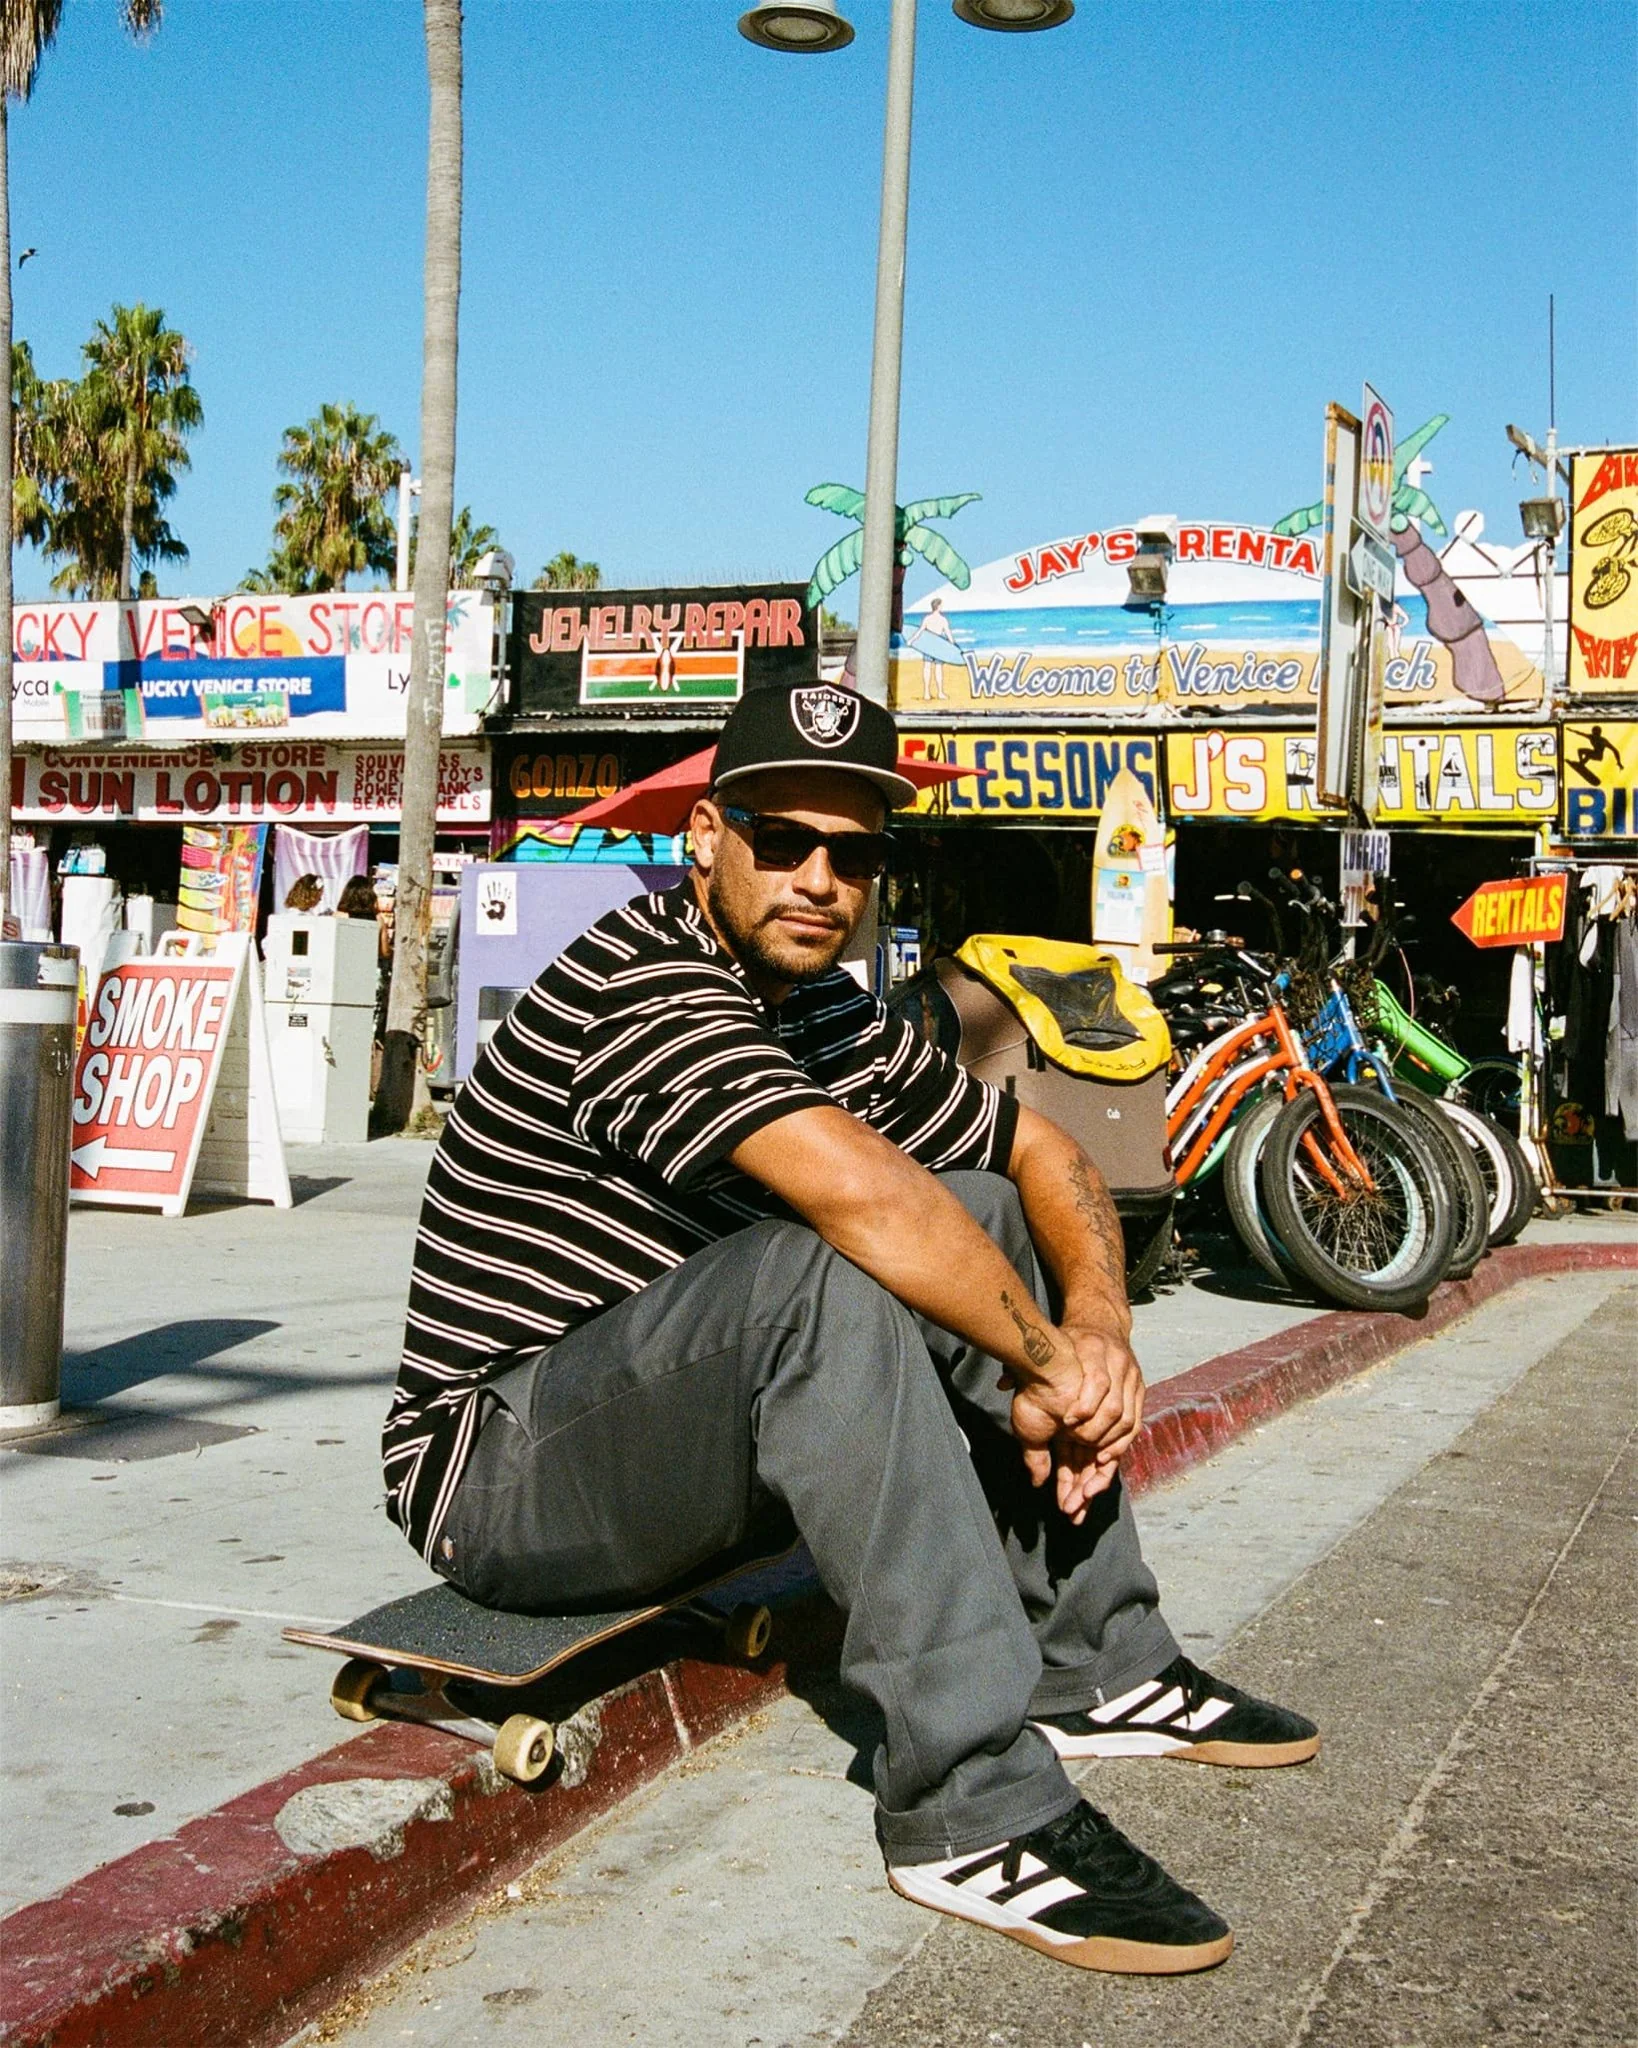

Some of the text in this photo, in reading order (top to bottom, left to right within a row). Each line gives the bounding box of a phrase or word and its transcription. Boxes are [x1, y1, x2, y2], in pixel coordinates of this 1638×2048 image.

[1006, 531, 1137, 591] JAY'S
[1178, 528, 1323, 578] RENTA
[16, 611, 98, 661] CKY
[308, 601, 453, 655] STOR
[529, 599, 805, 654] JEWELRY REPAIR
[192, 678, 254, 695] VENICE
[257, 676, 312, 695] STORE
[962, 651, 1116, 698] Welcome
[1124, 655, 1160, 696] to
[1168, 643, 1302, 696] Venice
[801, 691, 852, 706] RAIDERS
[44, 745, 326, 768] CONVENIENCE STORE
[355, 754, 460, 770] SOUVRS
[510, 754, 619, 799] GONZO
[949, 739, 1156, 809] LESSONS
[1172, 730, 1557, 812] J'S RNTALS
[38, 770, 135, 815] SUN
[156, 769, 339, 815] LOTION
[352, 796, 404, 811] BEAC
[354, 781, 471, 797] POWE ANK
[1472, 884, 1563, 938] RENTALS
[89, 976, 232, 1051] SMOKE
[73, 1052, 204, 1129] SHOP
